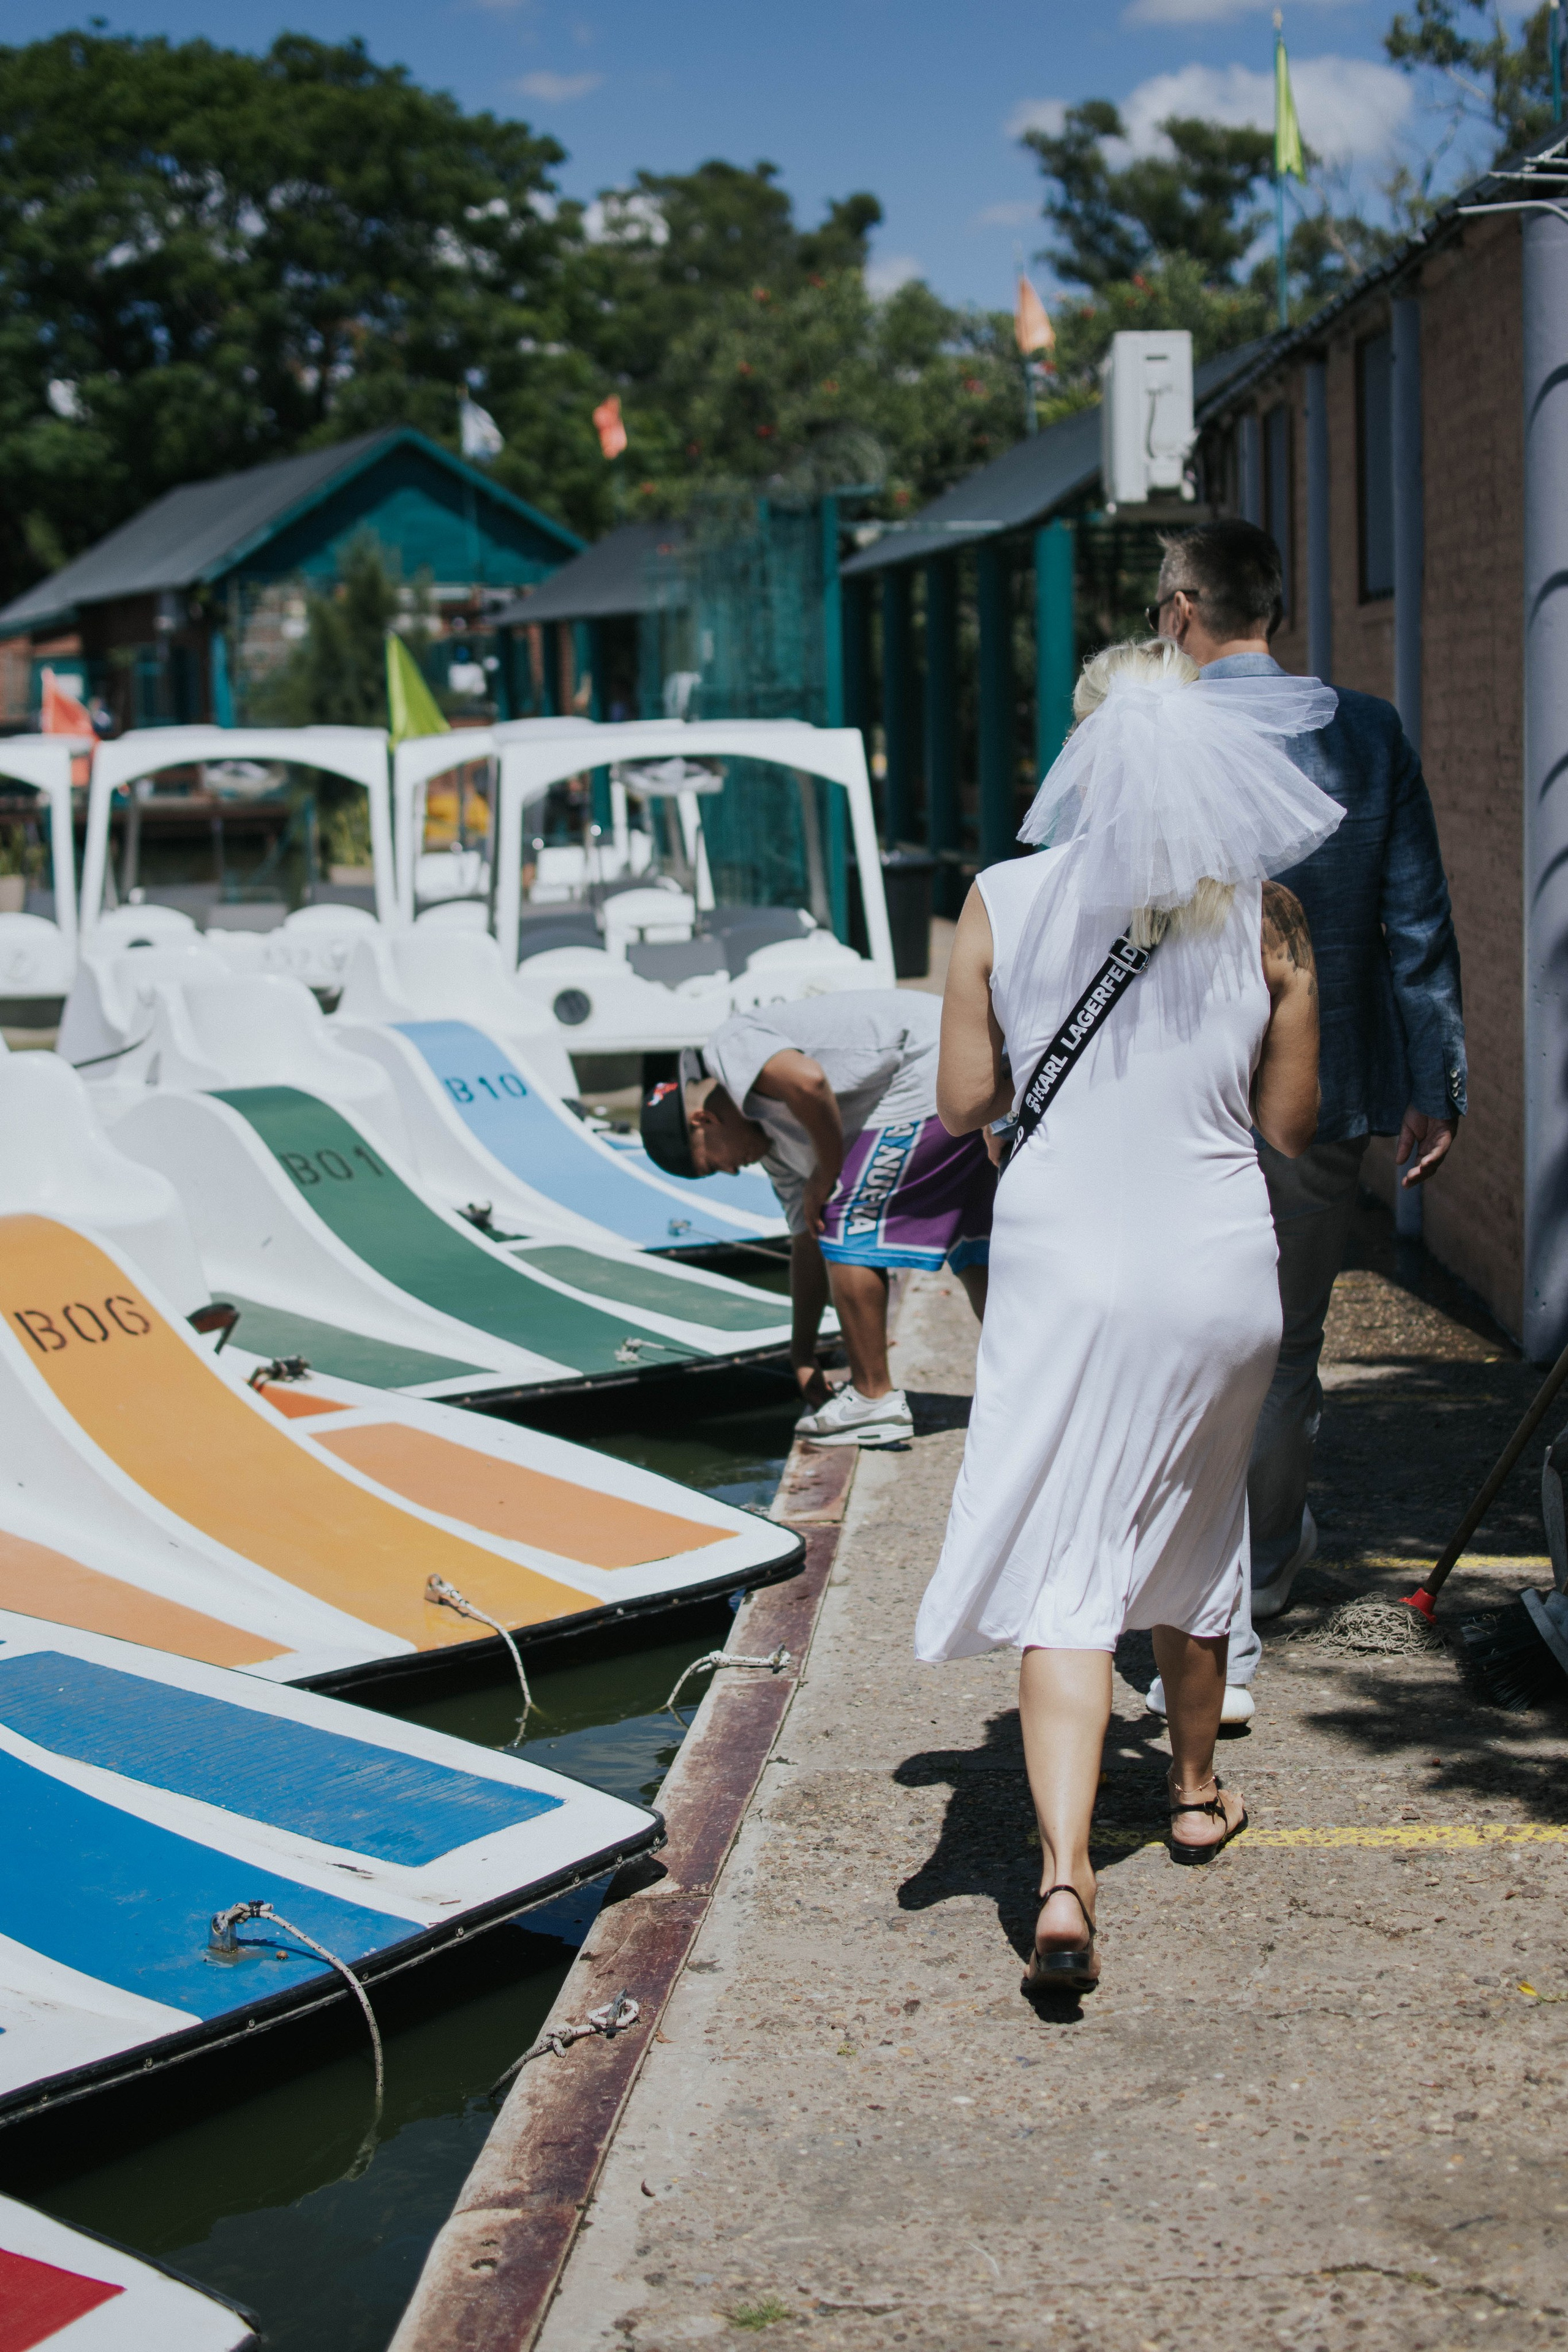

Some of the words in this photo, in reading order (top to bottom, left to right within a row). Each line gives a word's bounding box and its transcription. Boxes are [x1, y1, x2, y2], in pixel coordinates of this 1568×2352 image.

[444, 1074, 527, 1102] B10
[1032, 1054, 1068, 1101] KARL
[281, 1145, 385, 1185] B01
[847, 1144, 907, 1235] NUEVA
[14, 1295, 150, 1352] B06
